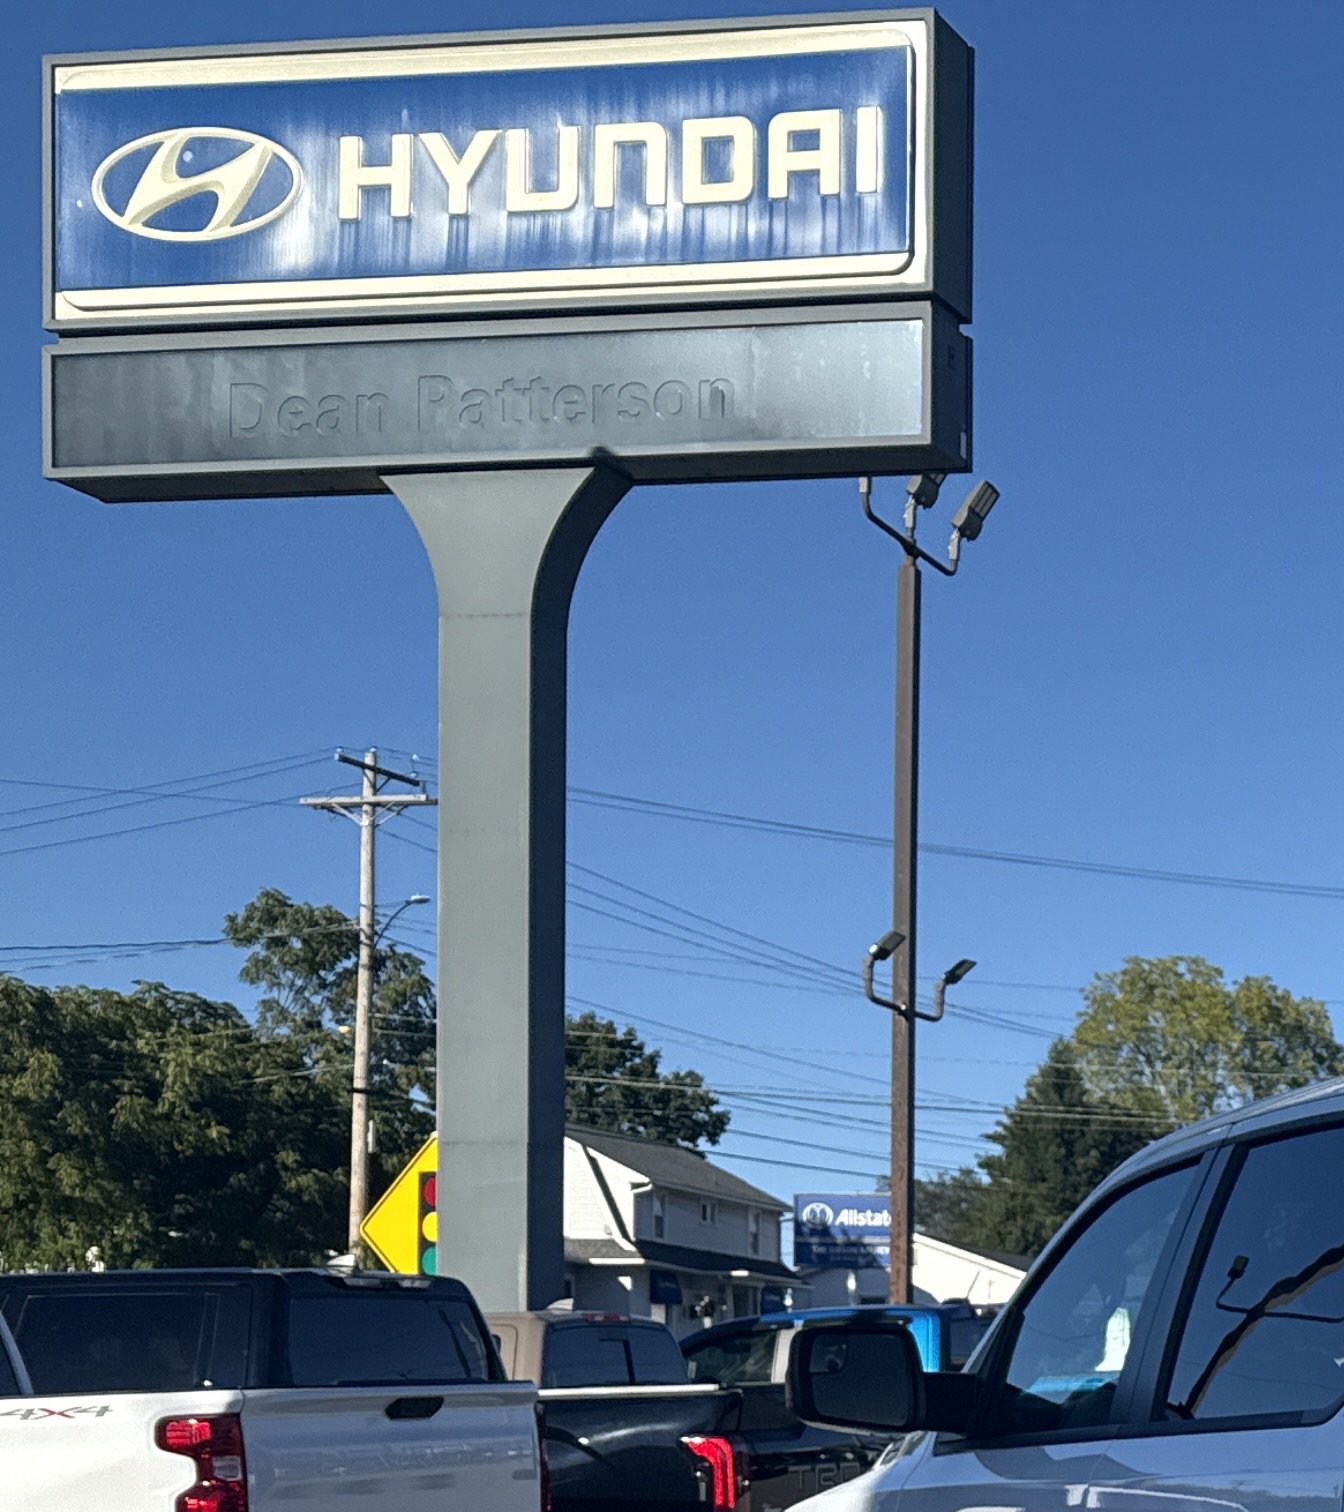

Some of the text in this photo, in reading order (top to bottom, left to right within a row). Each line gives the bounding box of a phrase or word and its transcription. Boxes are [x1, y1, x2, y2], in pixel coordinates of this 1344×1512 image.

[338, 105, 883, 220] HYUNDAI
[229, 374, 735, 439] Dean Patterson
